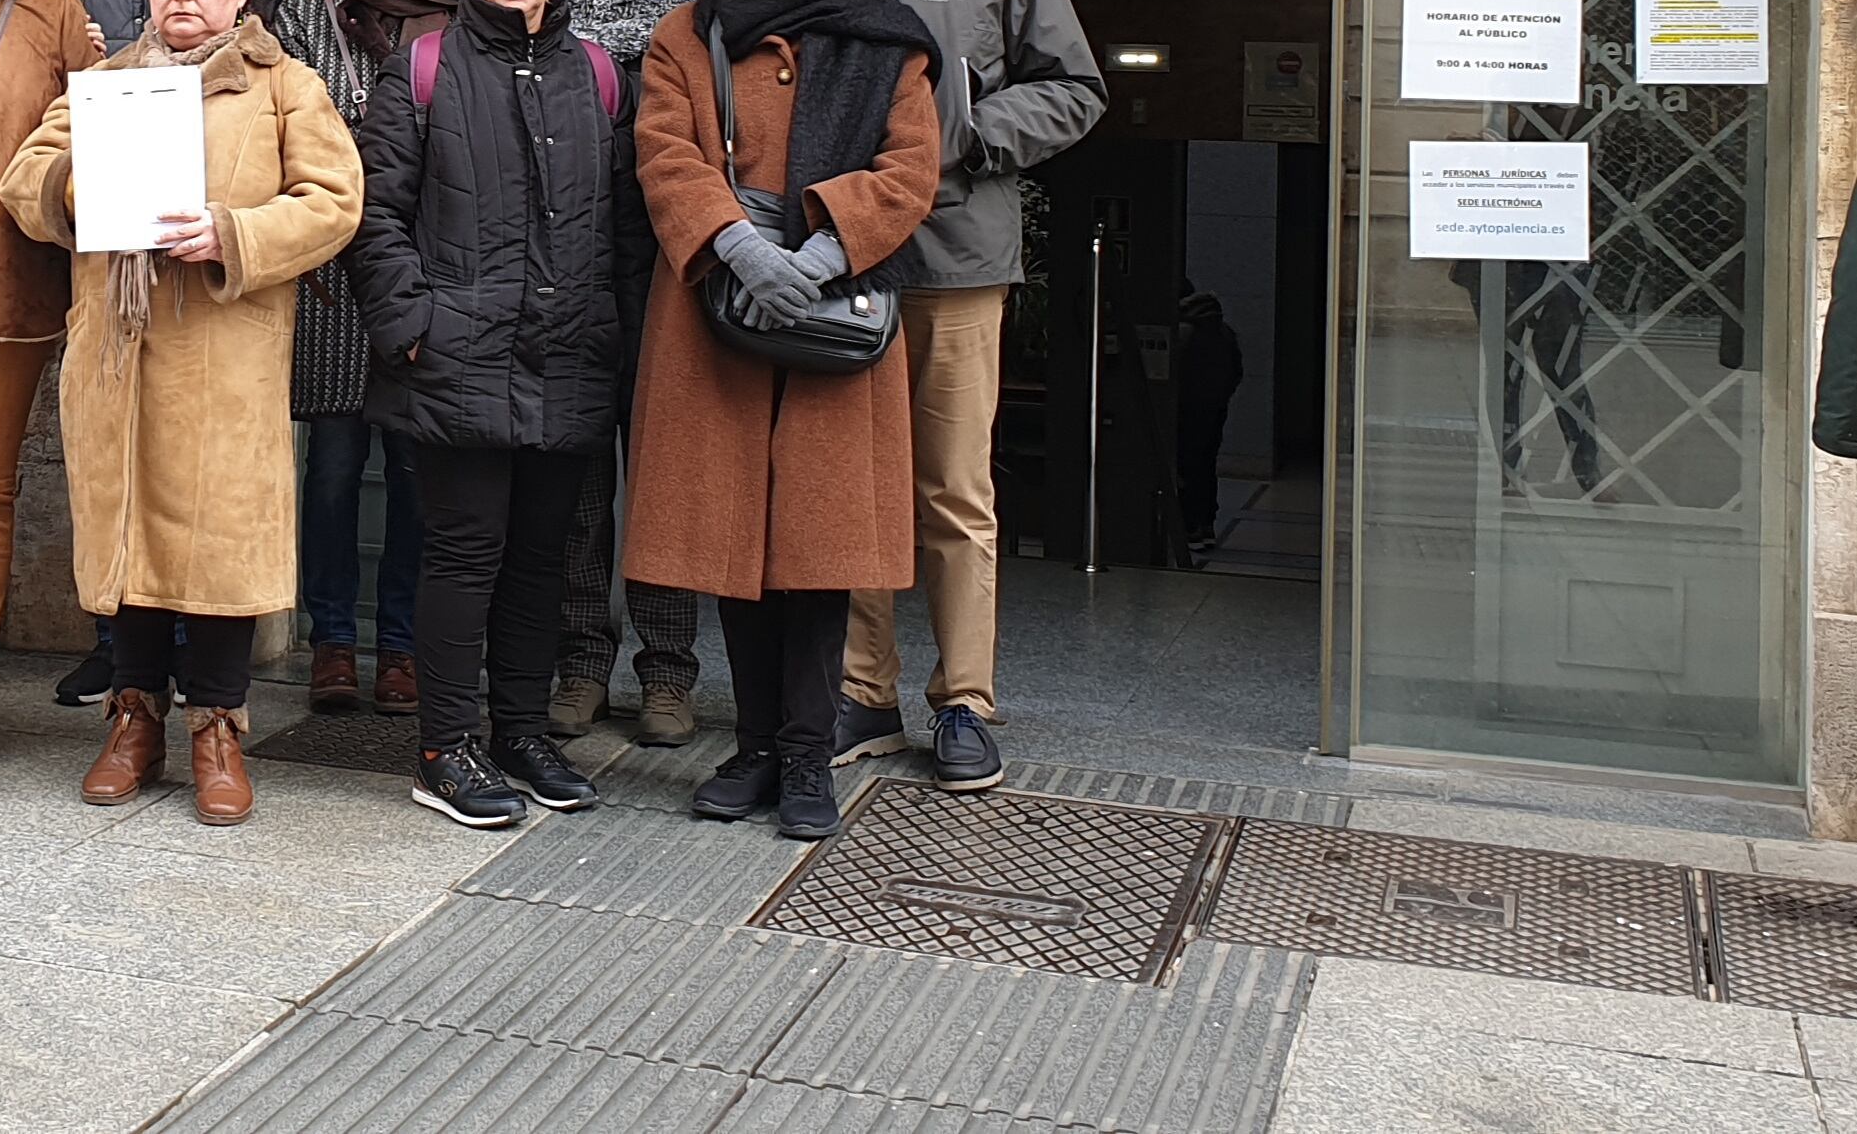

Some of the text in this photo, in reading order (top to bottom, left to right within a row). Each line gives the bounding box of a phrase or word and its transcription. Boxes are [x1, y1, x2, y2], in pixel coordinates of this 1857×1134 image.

[1427, 13, 1561, 24] HORARIO DE ATENCIÓN
[1459, 28, 1528, 38] AL PÚBLICO
[1436, 60, 1548, 71] 9:00 A 14:00 HORAS
[1443, 169, 1490, 178] PERSONAS
[1501, 168, 1547, 179] JURÍDICAS
[1457, 197, 1543, 208] SEDE ELECTRÓNICA
[1436, 223, 1565, 235] sede.aytopalencia.es
